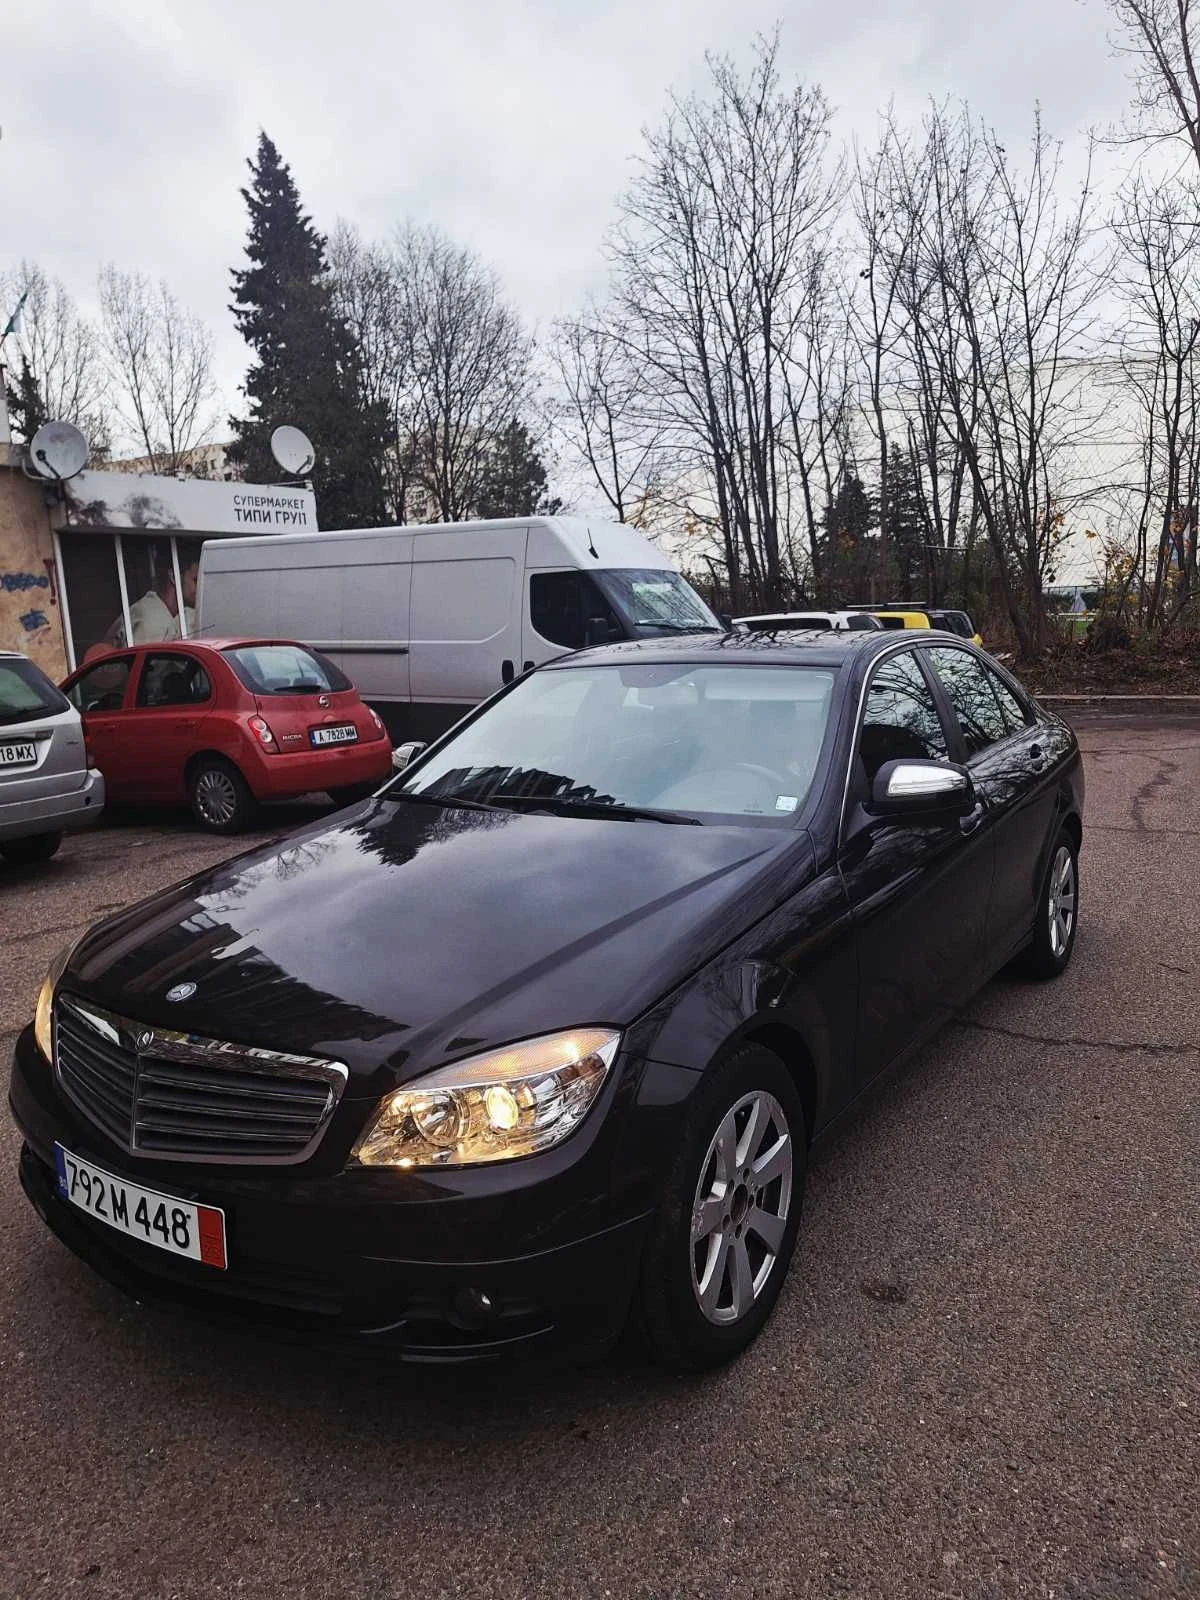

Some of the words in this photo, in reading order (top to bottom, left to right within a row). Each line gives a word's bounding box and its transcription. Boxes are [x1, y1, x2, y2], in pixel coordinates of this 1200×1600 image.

[233, 495, 304, 509] СУПЕРМАРКЕТ
[234, 508, 271, 523] ТИПИ
[276, 511, 307, 525] ГРУП
[134, 1196, 190, 1249] 448
